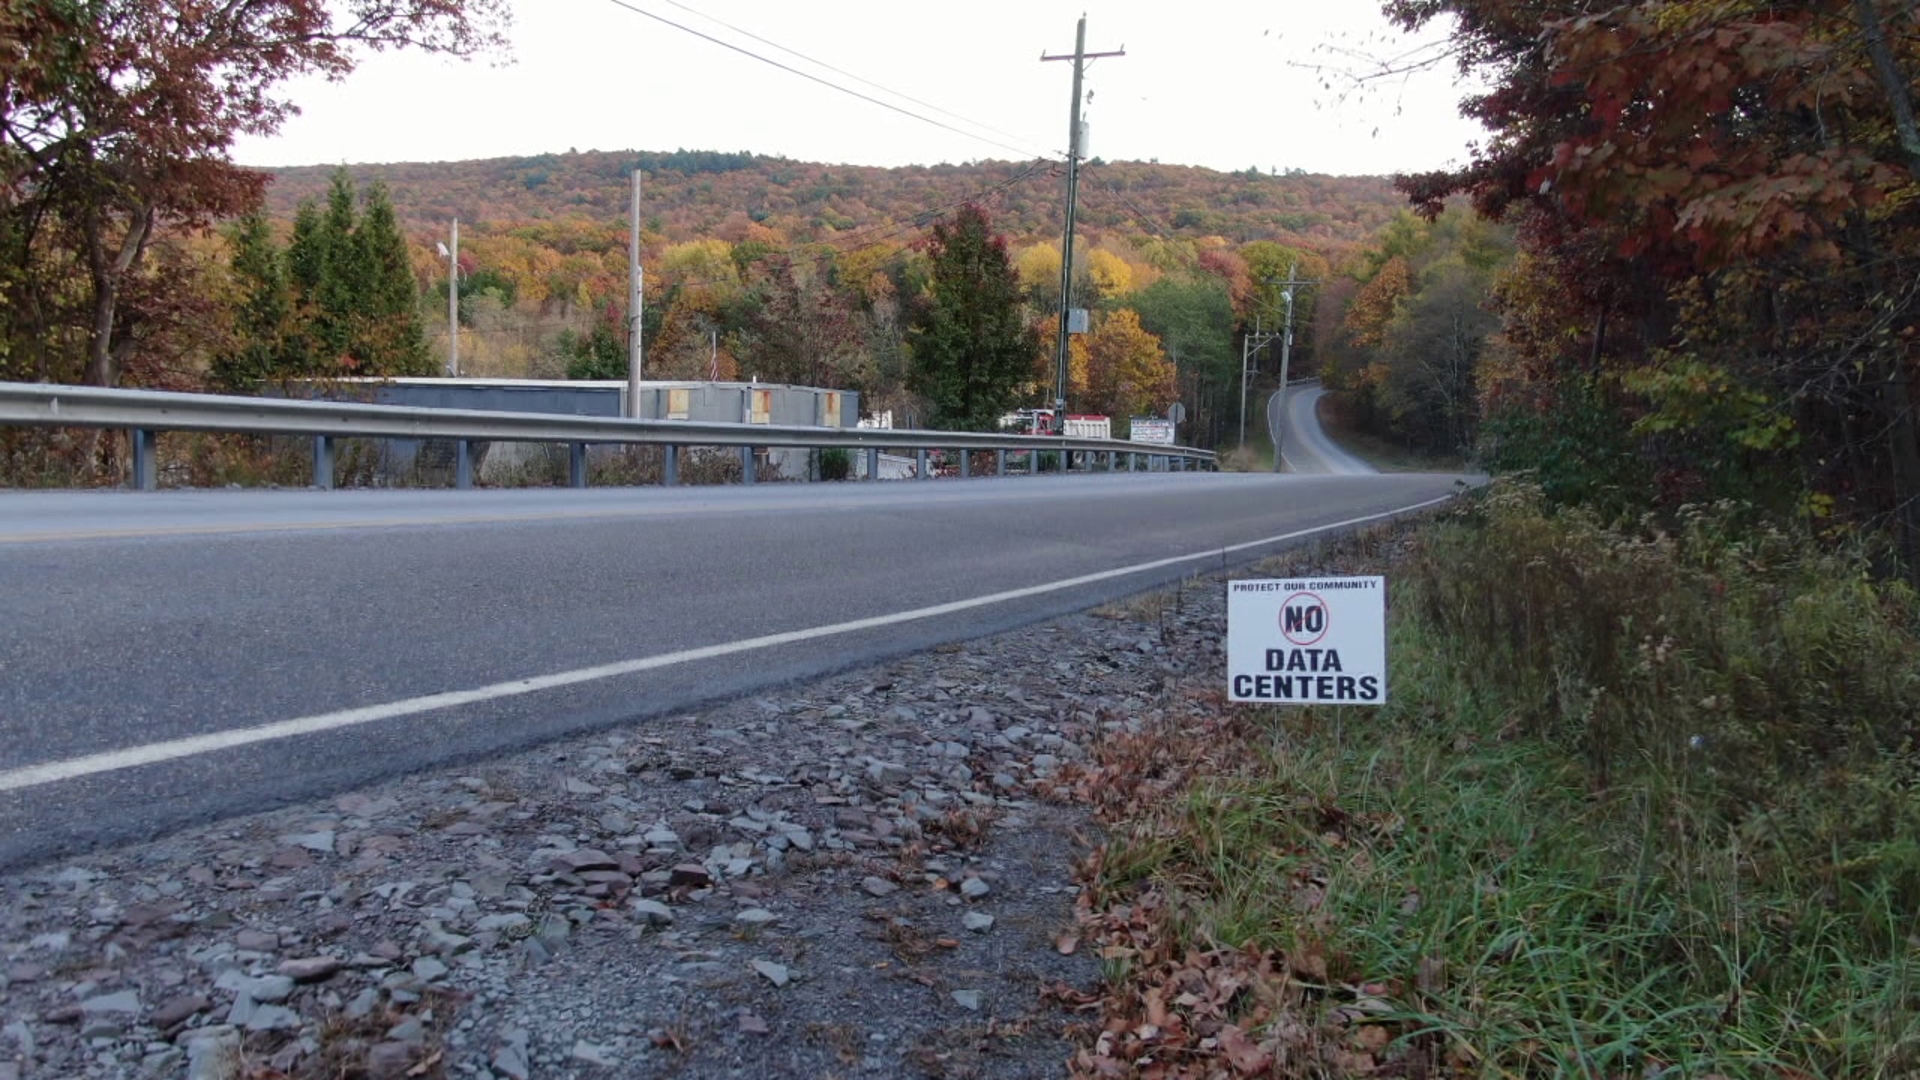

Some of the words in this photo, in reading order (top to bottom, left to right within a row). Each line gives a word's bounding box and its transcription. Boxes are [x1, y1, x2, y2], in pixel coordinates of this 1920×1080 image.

[1233, 583, 1281, 592] PROTECT
[1284, 582, 1306, 590] OUR
[1309, 580, 1377, 590] COMMUNITY
[1285, 605, 1323, 633] NO
[1265, 648, 1343, 672] DATA
[1233, 675, 1378, 700] CENTERS
